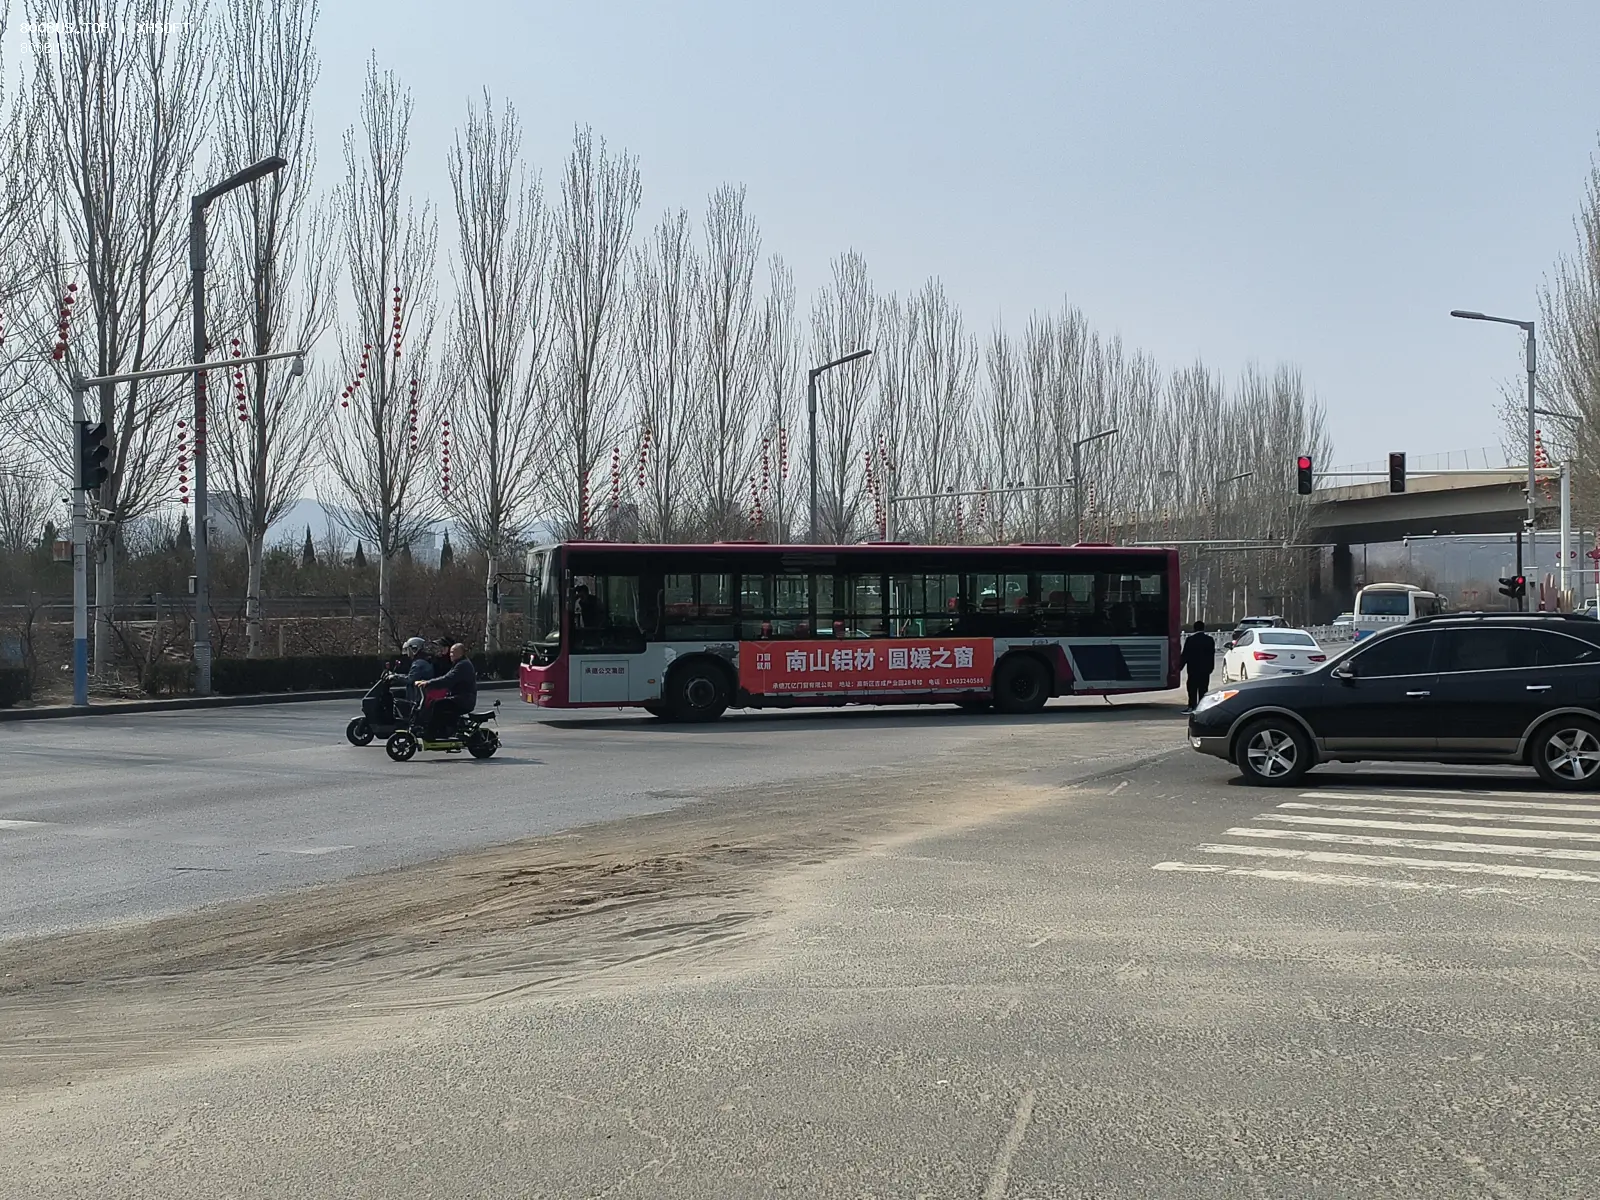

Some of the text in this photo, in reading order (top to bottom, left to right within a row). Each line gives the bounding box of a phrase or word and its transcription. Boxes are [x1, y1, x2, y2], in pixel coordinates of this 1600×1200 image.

[785, 647, 974, 672] 南山铝材·圆媛之窗
